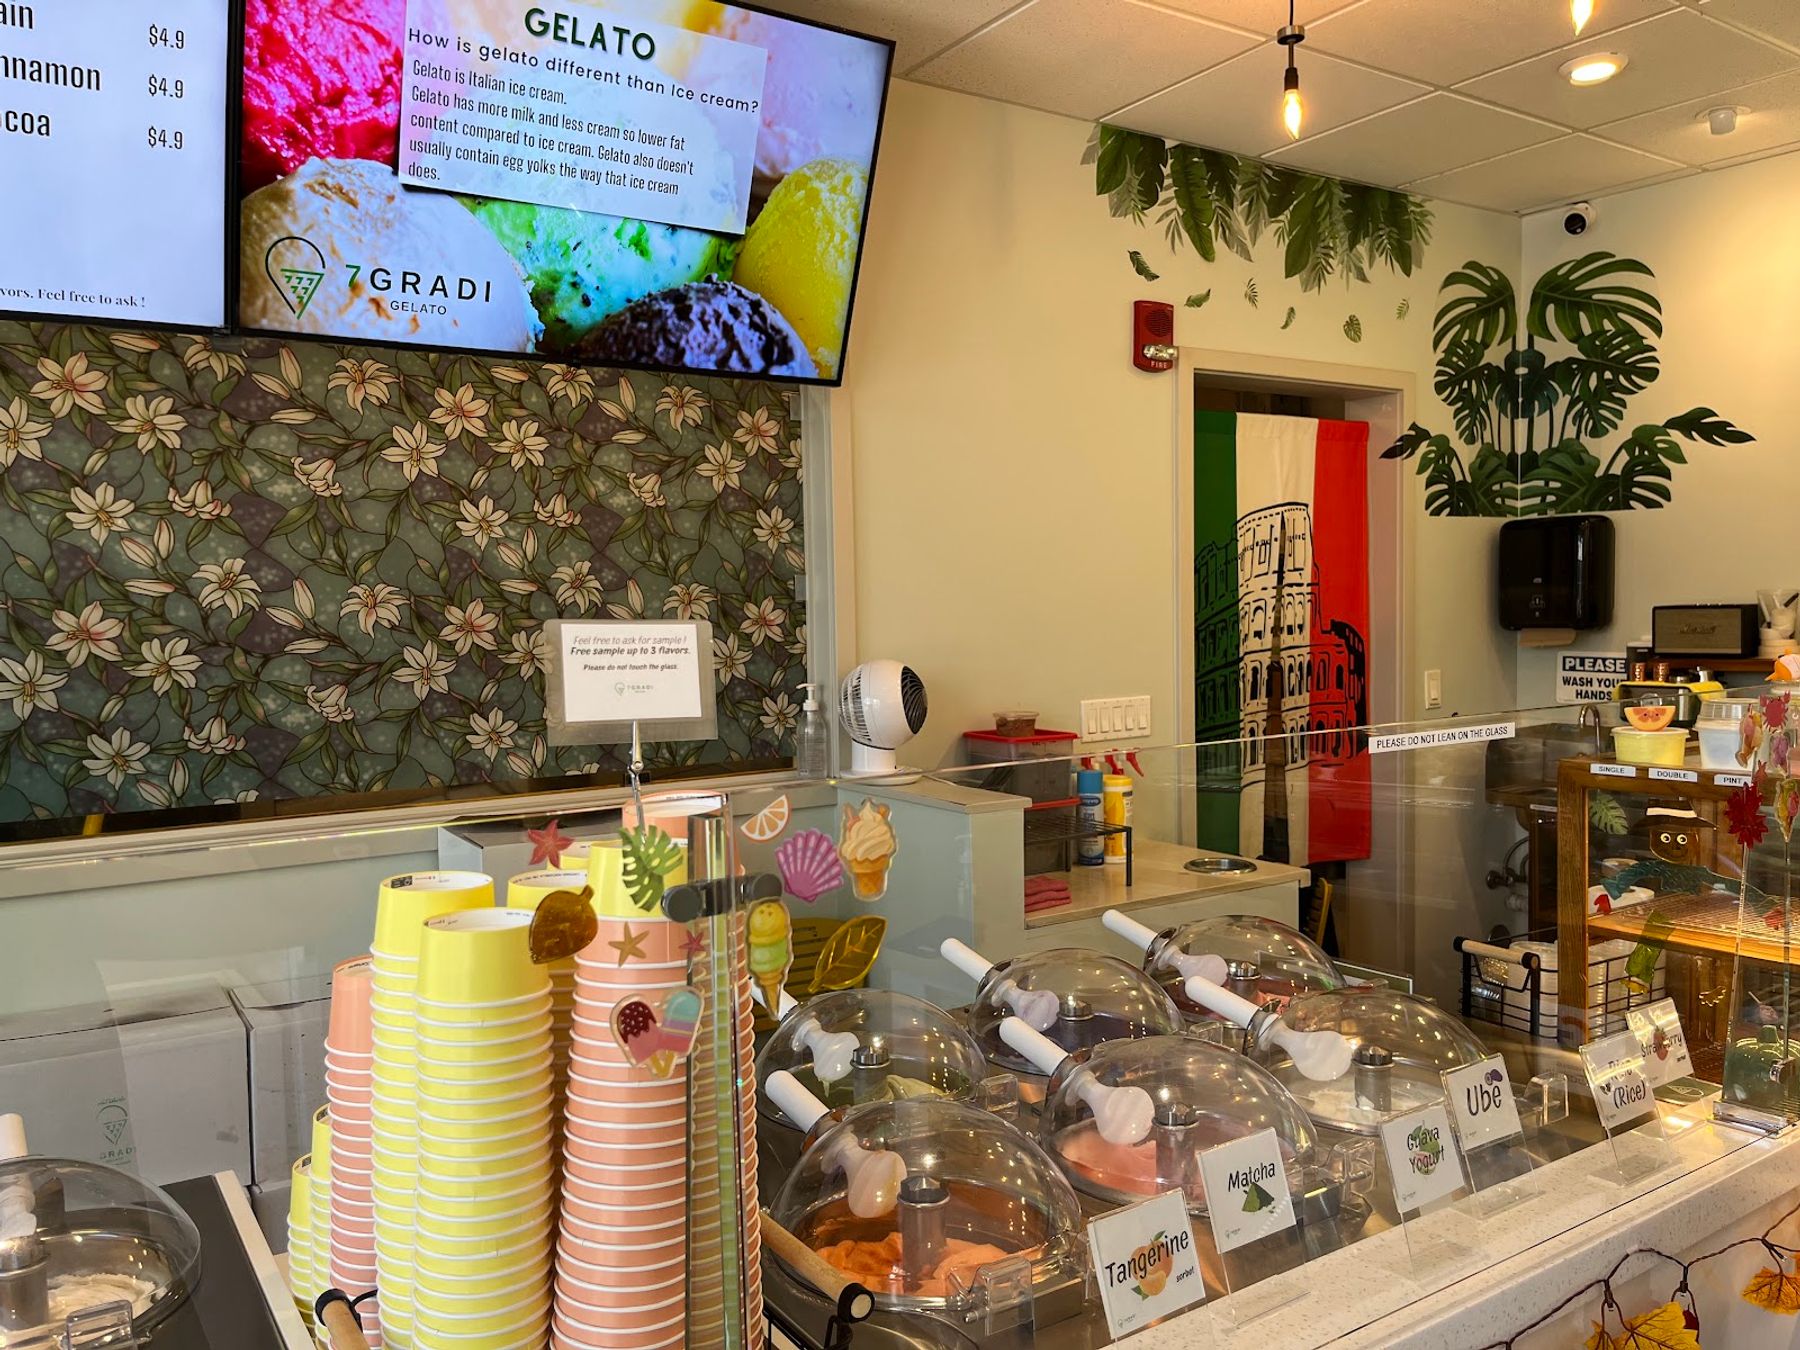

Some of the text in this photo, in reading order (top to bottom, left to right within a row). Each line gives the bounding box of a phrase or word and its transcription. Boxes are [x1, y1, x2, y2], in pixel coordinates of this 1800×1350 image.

[149, 24, 184, 49] $4.9
[525, 8, 655, 60] GELATO
[409, 28, 759, 113] How is gelato different than Ice cream?
[413, 60, 567, 105] Gelato is Italian ice cream.
[149, 74, 184, 99] $4.9
[0, 110, 50, 137] coa
[412, 86, 685, 151] Gelato has more milk and less cream so lower fat
[148, 126, 183, 150] $4.9
[411, 114, 694, 176] content compared to ice cream. Gelato also doesn't
[408, 162, 440, 181] does.
[410, 139, 679, 195] usually contain egg yolks the way that ice cream
[38, 288, 65, 301] Feel
[69, 290, 96, 304] free
[99, 294, 112, 305] to
[115, 295, 138, 307] ask
[390, 300, 447, 315] GELATO
[1151, 360, 1168, 369] FIRE
[570, 646, 691, 657] Free sample up to 3 flavors.
[573, 636, 591, 645] Feel
[592, 636, 609, 645] free
[612, 636, 620, 645] to
[622, 635, 636, 644] ask
[637, 635, 651, 645] for
[652, 635, 682, 646] sample
[1564, 657, 1626, 673] PLEASE
[1562, 676, 1626, 688] WASH YOU
[1575, 689, 1613, 701] HANDS
[1376, 726, 1508, 749] PLEASE DO NOT LEAN ON THE GLASS
[1598, 766, 1625, 774] SINGLE
[1657, 770, 1689, 780] DOUBLE
[1723, 777, 1742, 785] PINT
[1466, 1083, 1502, 1117] Ube
[1613, 1080, 1646, 1110] (Rice)
[1407, 1127, 1440, 1151] Guava
[1409, 1145, 1445, 1174] Yogurt
[1228, 1162, 1276, 1193] Matcha
[1105, 1230, 1189, 1288] Tangerine
[1176, 1265, 1195, 1283] sorbet
